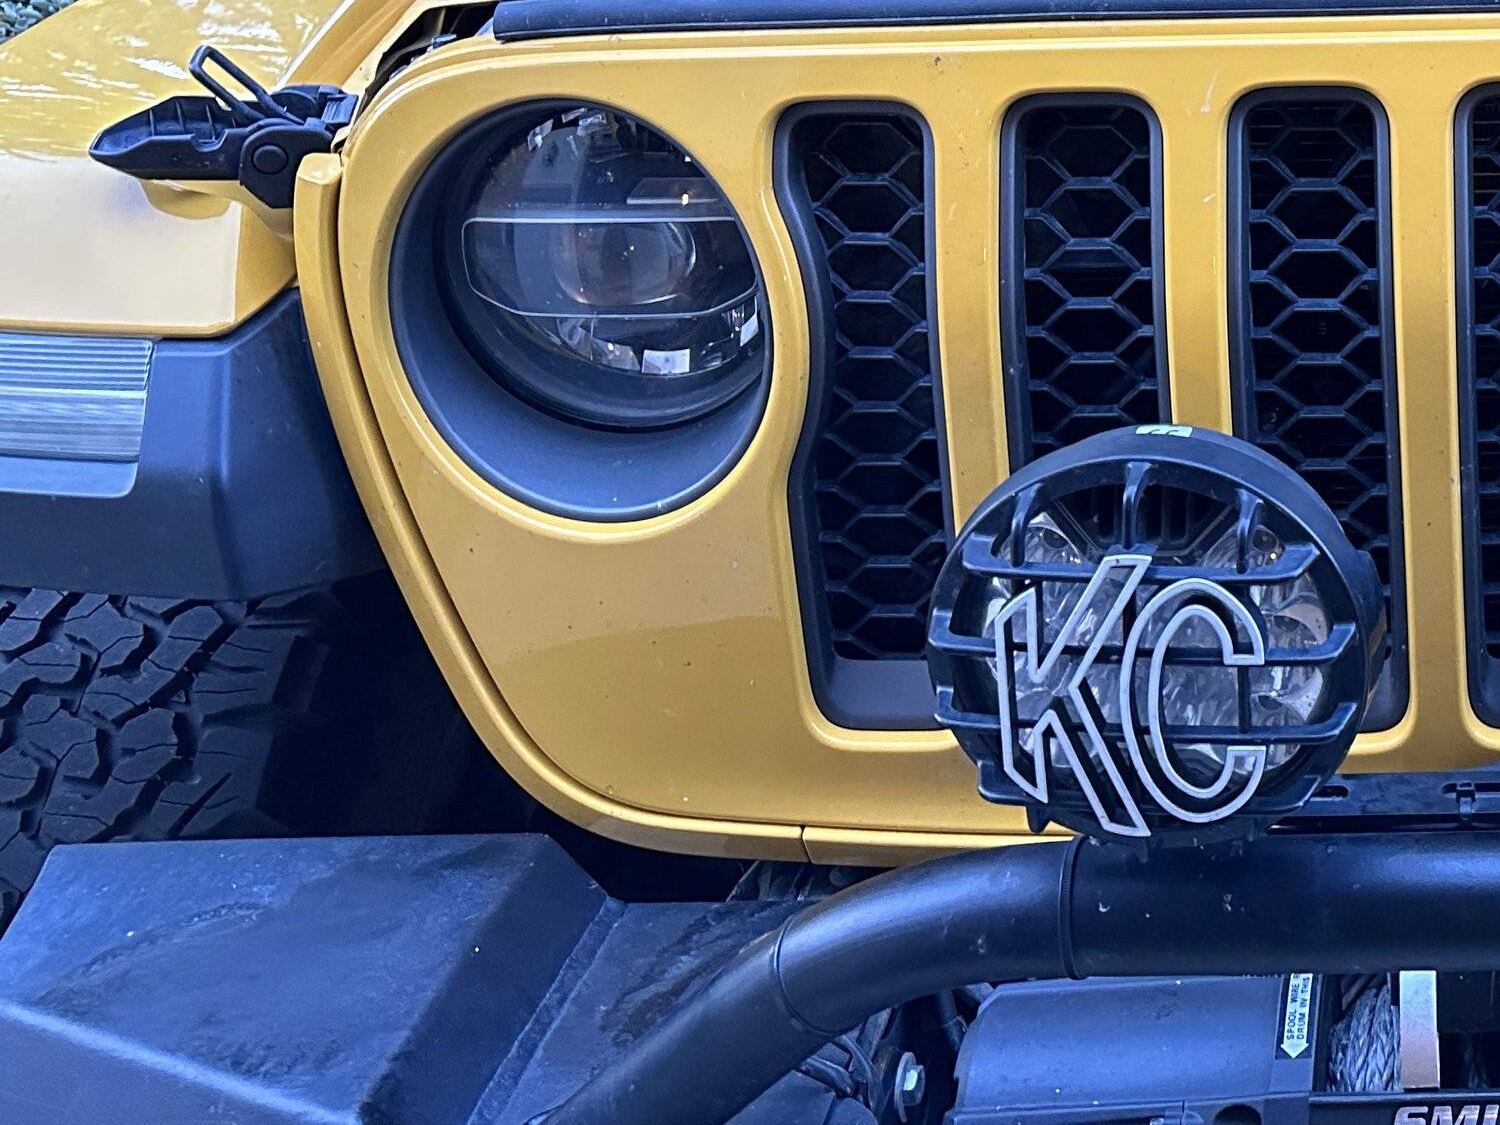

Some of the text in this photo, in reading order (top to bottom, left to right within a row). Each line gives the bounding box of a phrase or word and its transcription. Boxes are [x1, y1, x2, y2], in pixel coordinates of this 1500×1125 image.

[996, 554, 1266, 837] KC
[1290, 983, 1299, 1004] WIRE
[1287, 1009, 1298, 1040] SPOOL
[1297, 1013, 1306, 1040] DRUM
